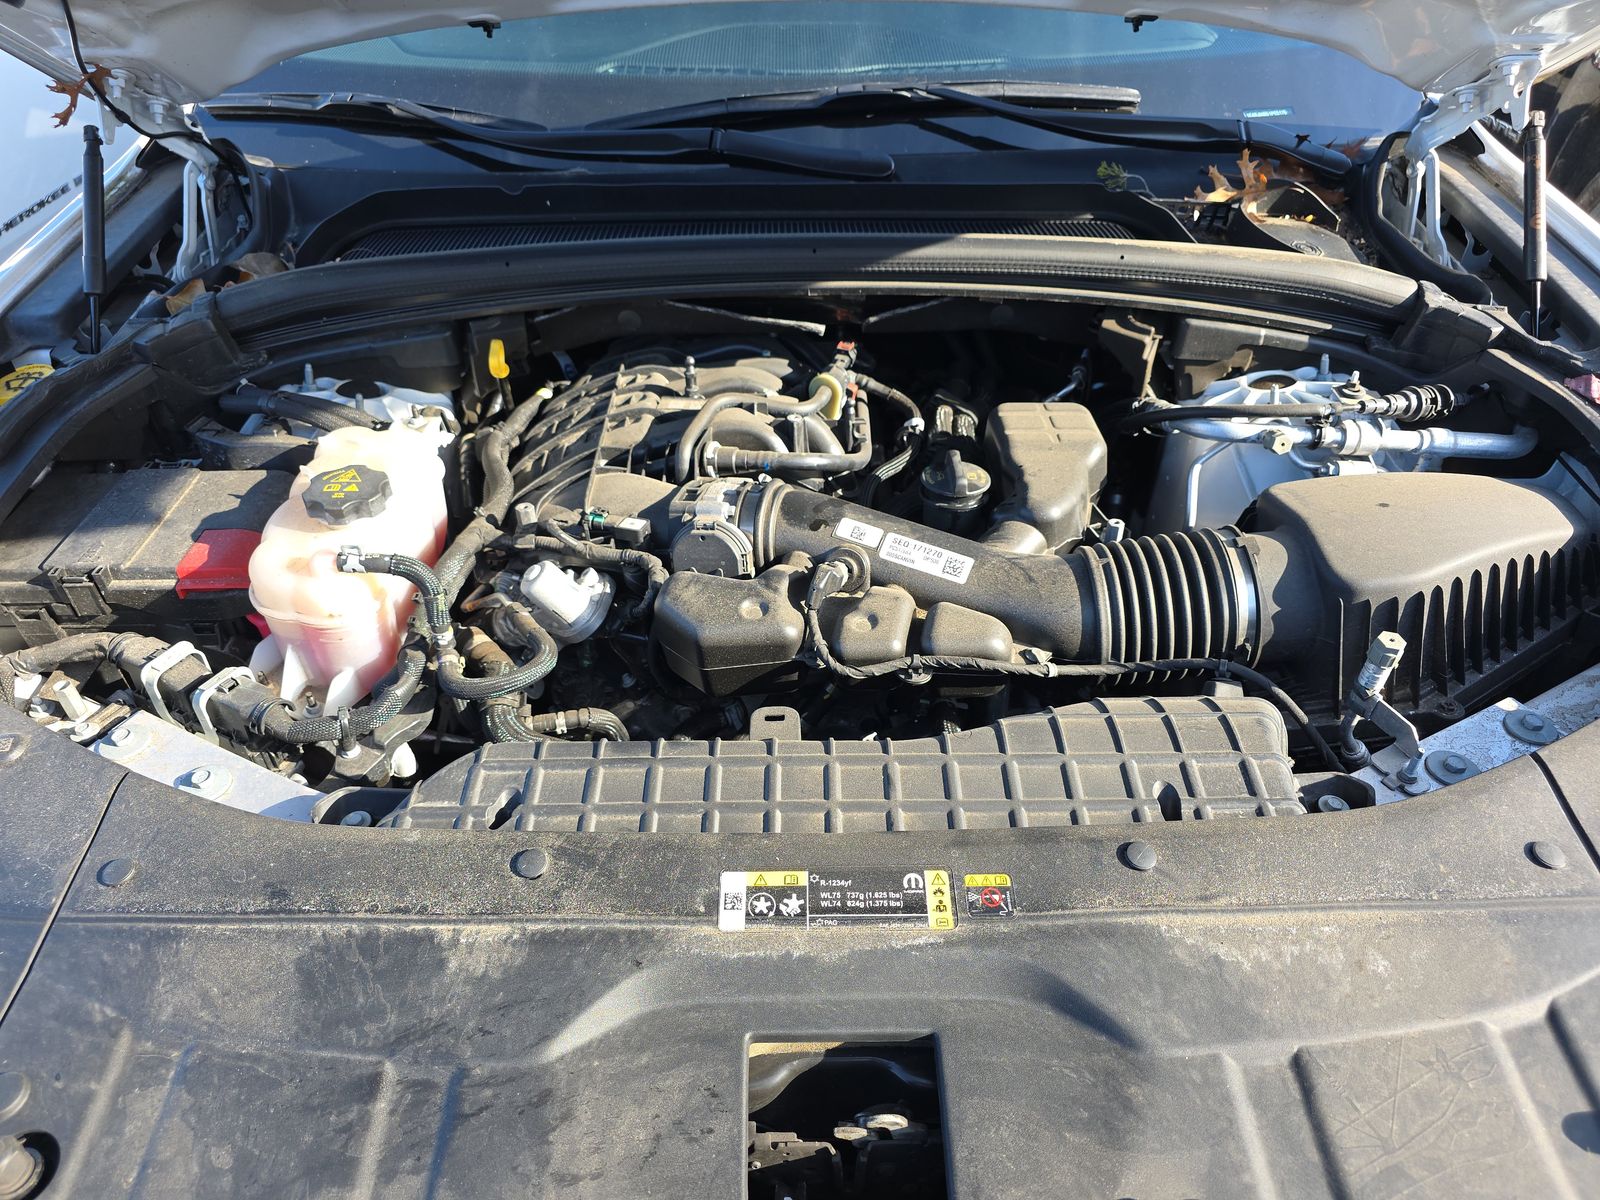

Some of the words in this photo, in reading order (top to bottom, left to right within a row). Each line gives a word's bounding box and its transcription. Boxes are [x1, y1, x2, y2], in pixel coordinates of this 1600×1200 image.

[820, 880, 852, 888] R-1234yf
[846, 891, 865, 900] 737g
[888, 891, 903, 901] lbs)
[820, 900, 841, 908] WL74
[866, 900, 888, 909] (1.375
[888, 900, 904, 909] lbs)
